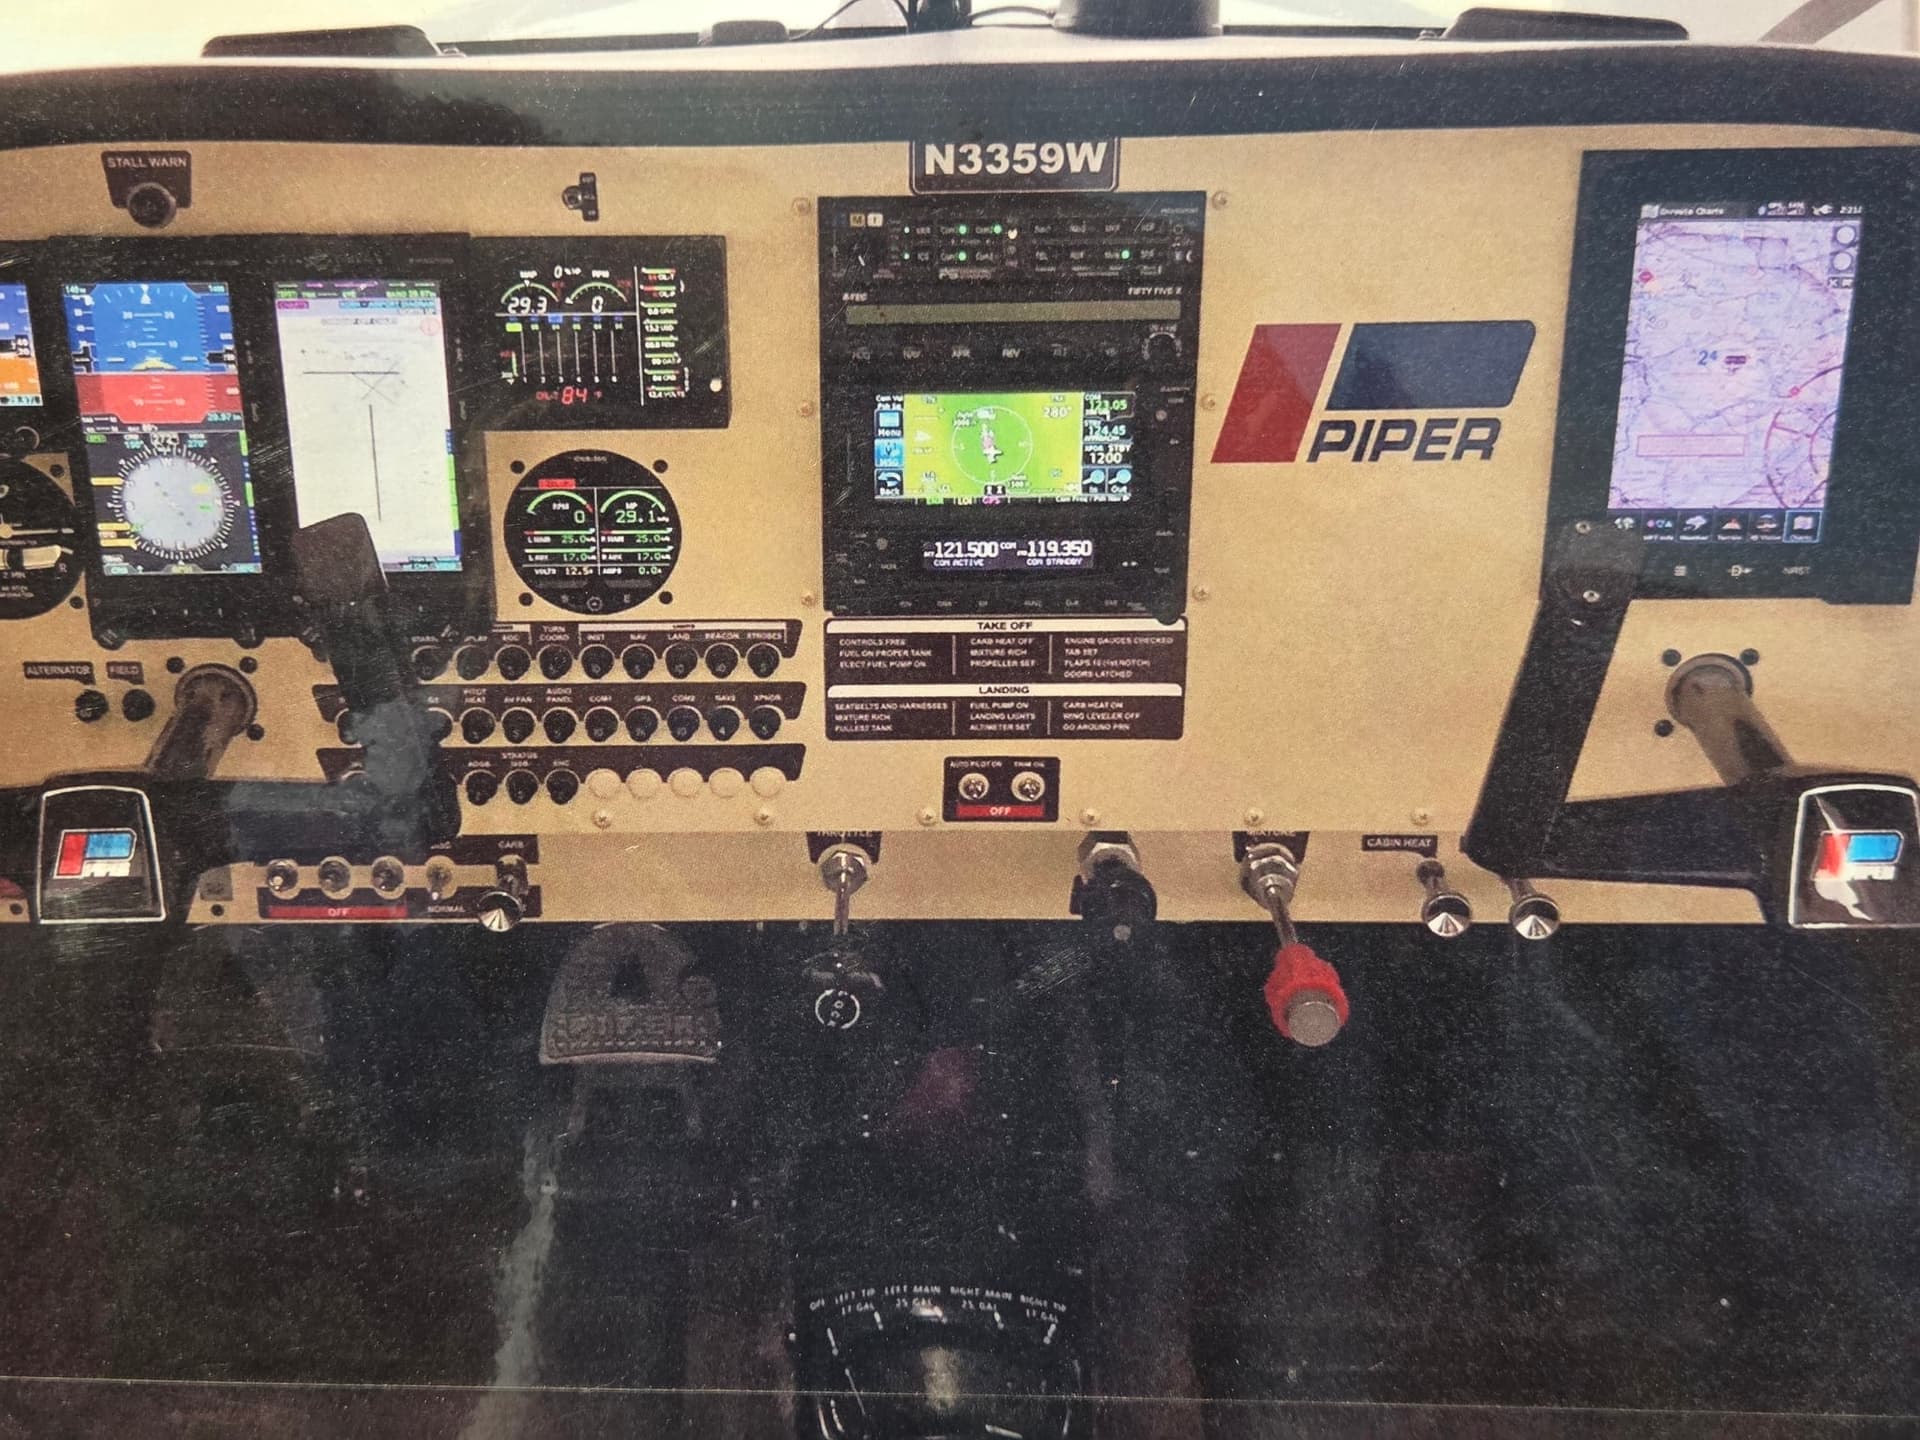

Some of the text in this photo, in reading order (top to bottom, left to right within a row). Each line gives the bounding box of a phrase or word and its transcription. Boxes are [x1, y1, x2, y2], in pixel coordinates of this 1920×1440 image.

[107, 156, 187, 169] STALL WARN
[924, 142, 1107, 175] N3359W
[1128, 287, 1152, 295] FIFTY
[1154, 287, 1173, 295] FIVE
[507, 297, 547, 315] 29.3
[591, 296, 604, 315] 0
[562, 386, 588, 405] 84
[1090, 400, 1127, 411] 123.05
[1089, 425, 1126, 436] 124.45
[1306, 418, 1501, 462] PIPER
[1108, 444, 1131, 452] STBY
[1090, 452, 1122, 464] 1200
[574, 510, 585, 523] 0
[616, 511, 656, 523] 29.1
[561, 535, 586, 544] 25.0
[636, 535, 660, 543] 25.0
[934, 541, 999, 558] 121.500
[1028, 540, 1093, 557] 119.350
[563, 553, 586, 561] 17.0
[637, 553, 661, 561] 17.0
[934, 559, 985, 567] COM ACTIVE
[1026, 558, 1043, 566] COM
[59, 563, 68, 573] R
[565, 566, 588, 575] 12.5
[638, 567, 658, 575] 0.0
[977, 622, 1033, 630] TAKE OFF
[630, 633, 647, 641] NAV
[1018, 637, 1033, 645] OFF
[1064, 637, 1174, 645] ENGINE GAUGES CHECKED
[875, 649, 909, 657] PROPER
[1083, 648, 1098, 656] SET
[27, 665, 91, 675] ALTERNATOR
[109, 665, 140, 674] FIELD
[979, 686, 1029, 694] LANDING
[835, 703, 879, 711] SEATBELTS
[900, 702, 948, 710] HARNESSES
[1063, 701, 1123, 709] CARB HEAT ON
[1063, 723, 1112, 731] GO AROUND
[950, 761, 969, 769] AUTO
[990, 806, 1011, 815] OFF
[498, 840, 524, 849] CARB
[1367, 838, 1431, 847] CABIN HEAT
[328, 908, 350, 917] OFF
[885, 1285, 940, 1295] LEFT MAIN
[950, 1286, 1012, 1300] RIGHT MAIN
[835, 1290, 855, 1304] LEFT
[1020, 1294, 1048, 1307] RIGHT
[856, 1302, 875, 1311] GAL
[979, 1302, 997, 1310] GAL
[1041, 1311, 1059, 1323] GAL
